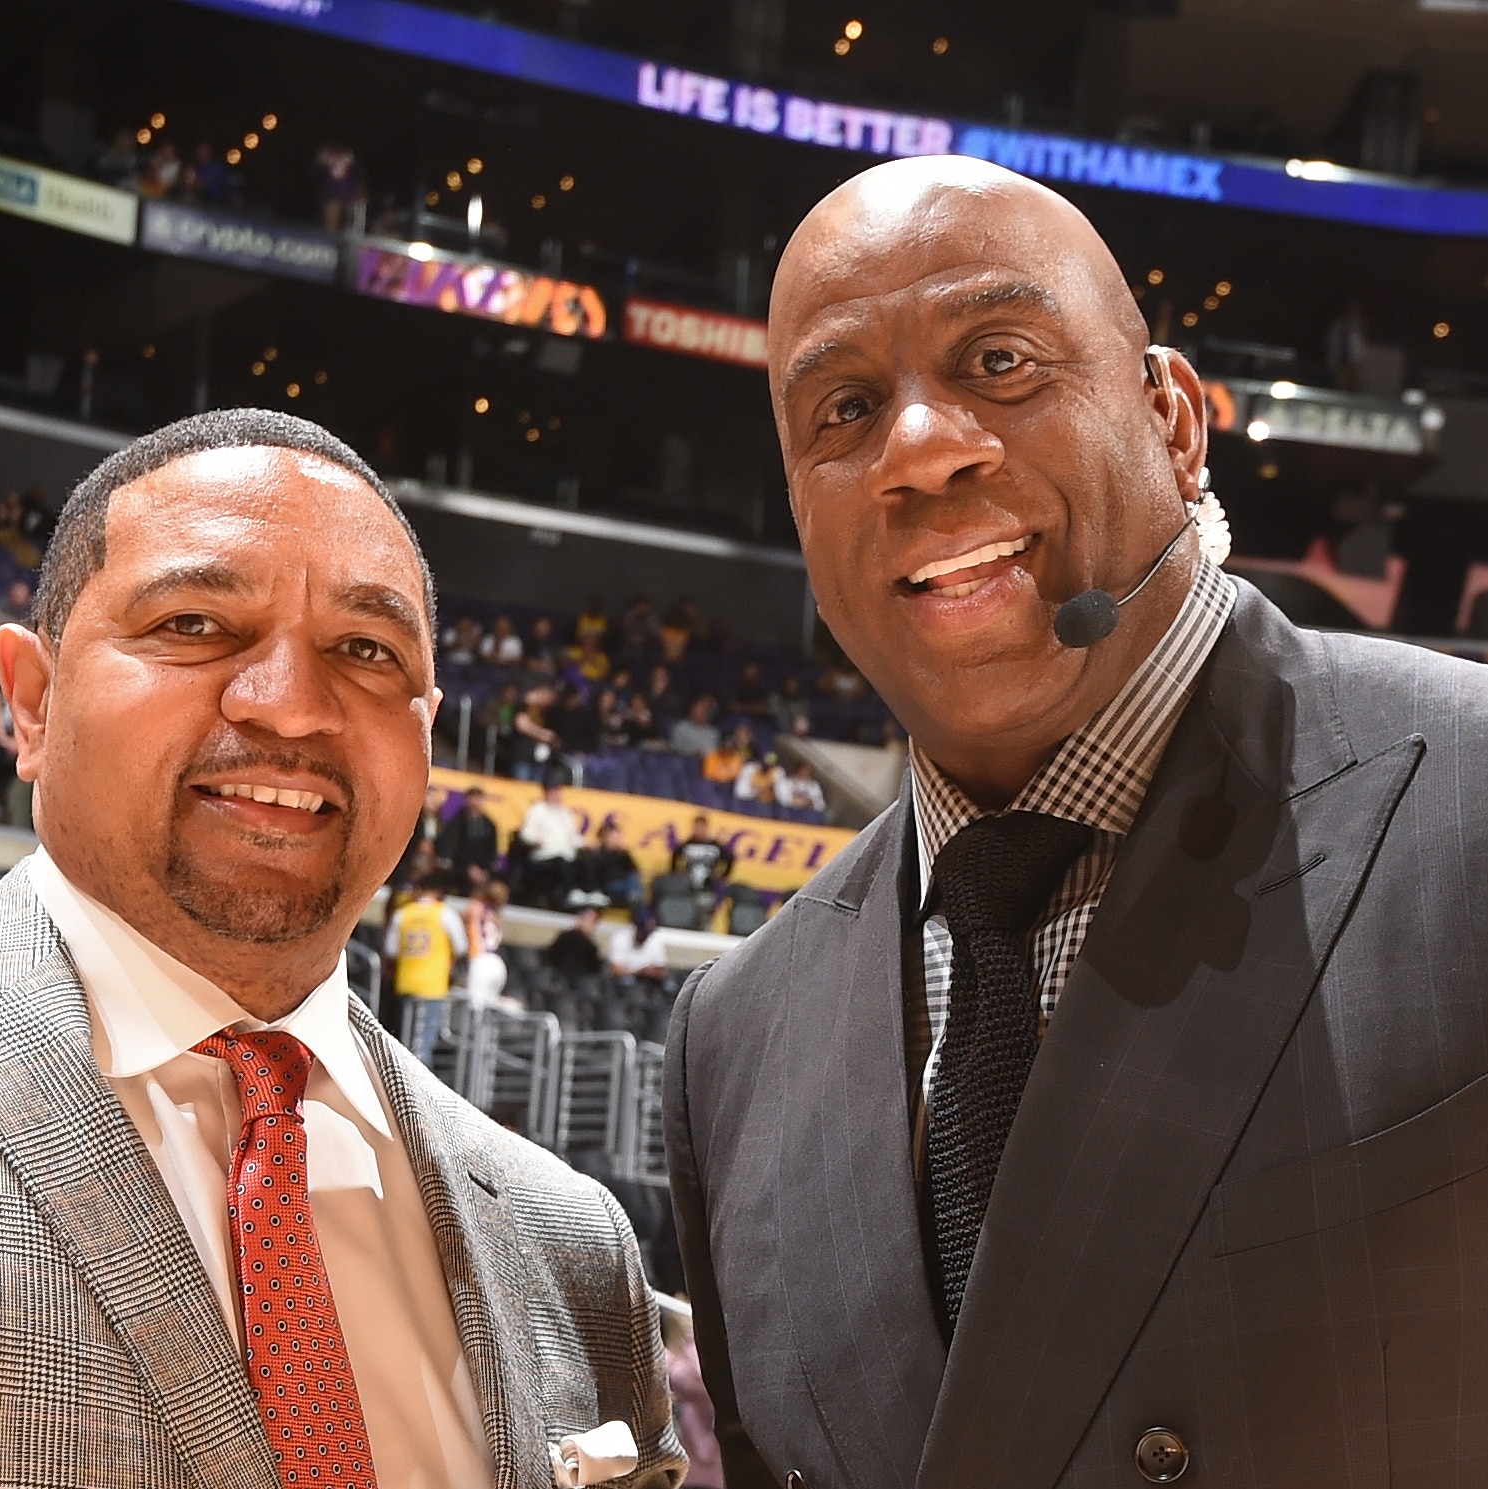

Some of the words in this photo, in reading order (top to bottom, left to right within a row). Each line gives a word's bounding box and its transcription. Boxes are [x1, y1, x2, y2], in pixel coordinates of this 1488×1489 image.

[637, 61, 730, 124] LIFE
[732, 84, 781, 134] IS
[784, 95, 954, 158] BETTER
[627, 302, 769, 363] TOSHIB
